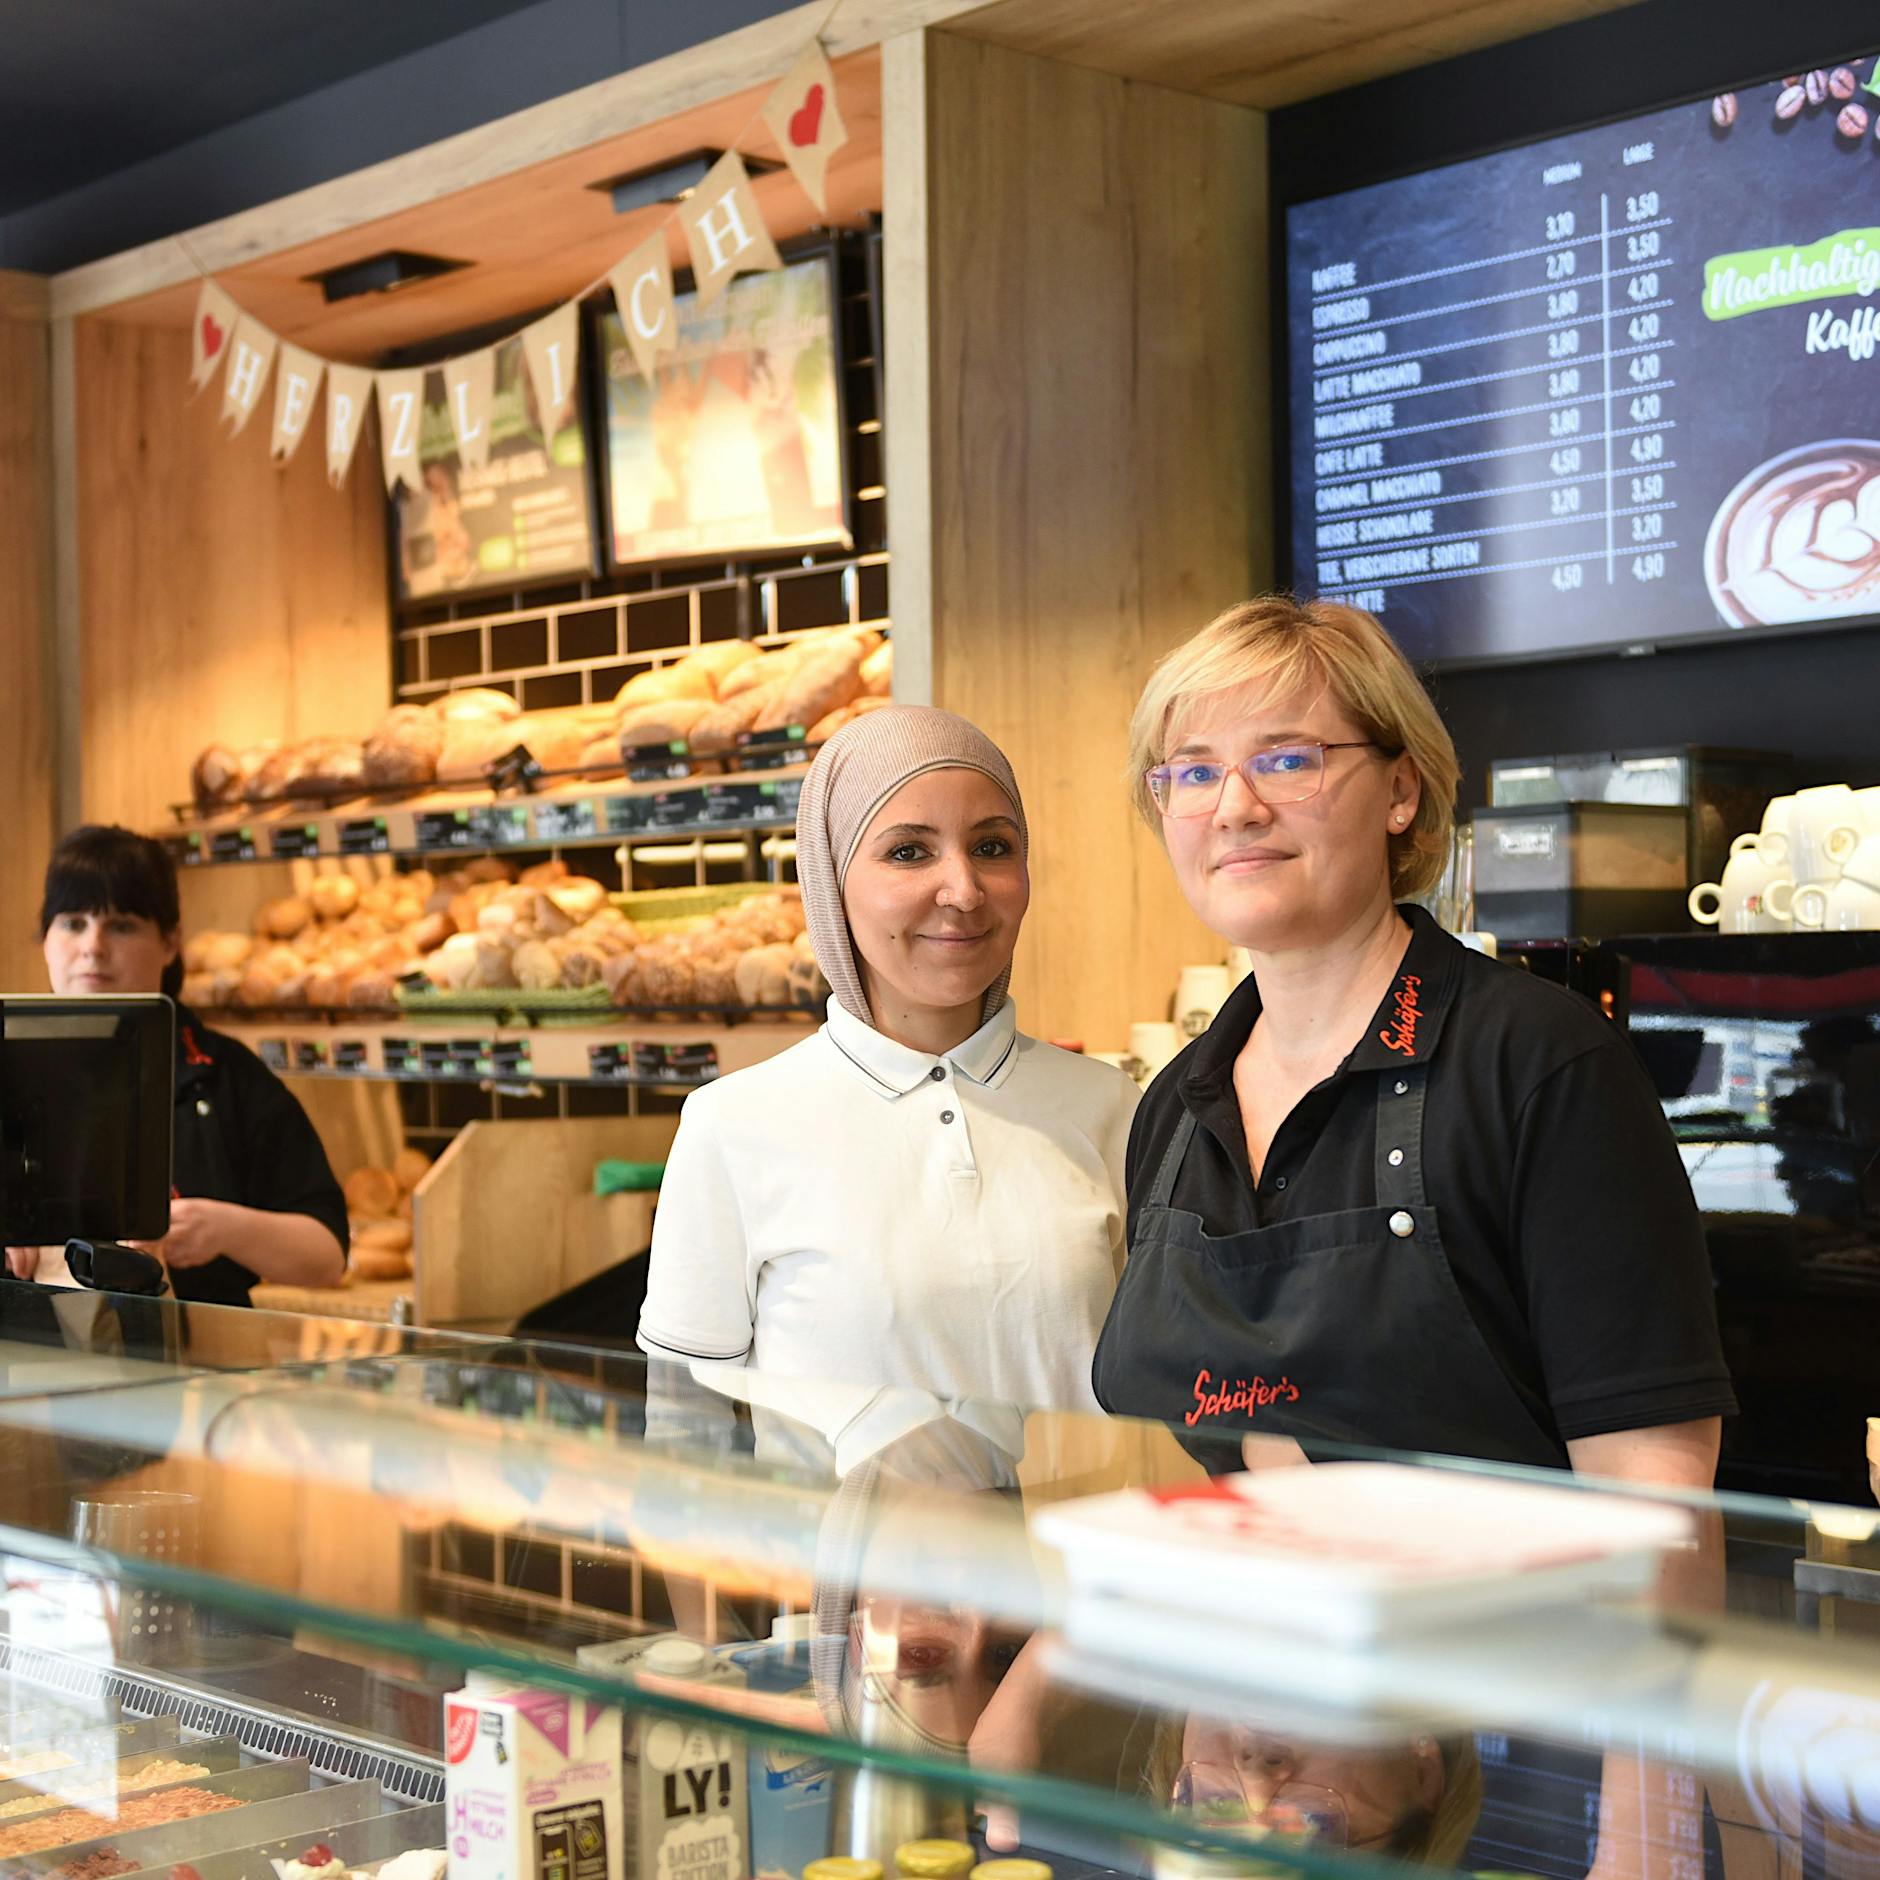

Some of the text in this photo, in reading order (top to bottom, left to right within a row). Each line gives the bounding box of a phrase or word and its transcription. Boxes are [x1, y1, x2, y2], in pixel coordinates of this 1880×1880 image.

[1626, 191, 1659, 223] 3,50
[1627, 231, 1660, 262] 3,50
[228, 187, 755, 458] HERZLICH
[1314, 375, 1350, 403] LATTE
[1345, 442, 1383, 470] LATTE
[1358, 509, 1433, 543] SCHOKOLADE
[1632, 474, 1663, 503] 3,50
[1431, 541, 1480, 570] SORTEN
[1552, 563, 1582, 592] 4,50
[1632, 553, 1664, 582] 4,90
[1380, 975, 1424, 1056] Schäfer's
[1185, 1369, 1300, 1428] Schäfer's
[664, 1762, 730, 1819] LY!
[667, 1836, 730, 1868] BARISTA
